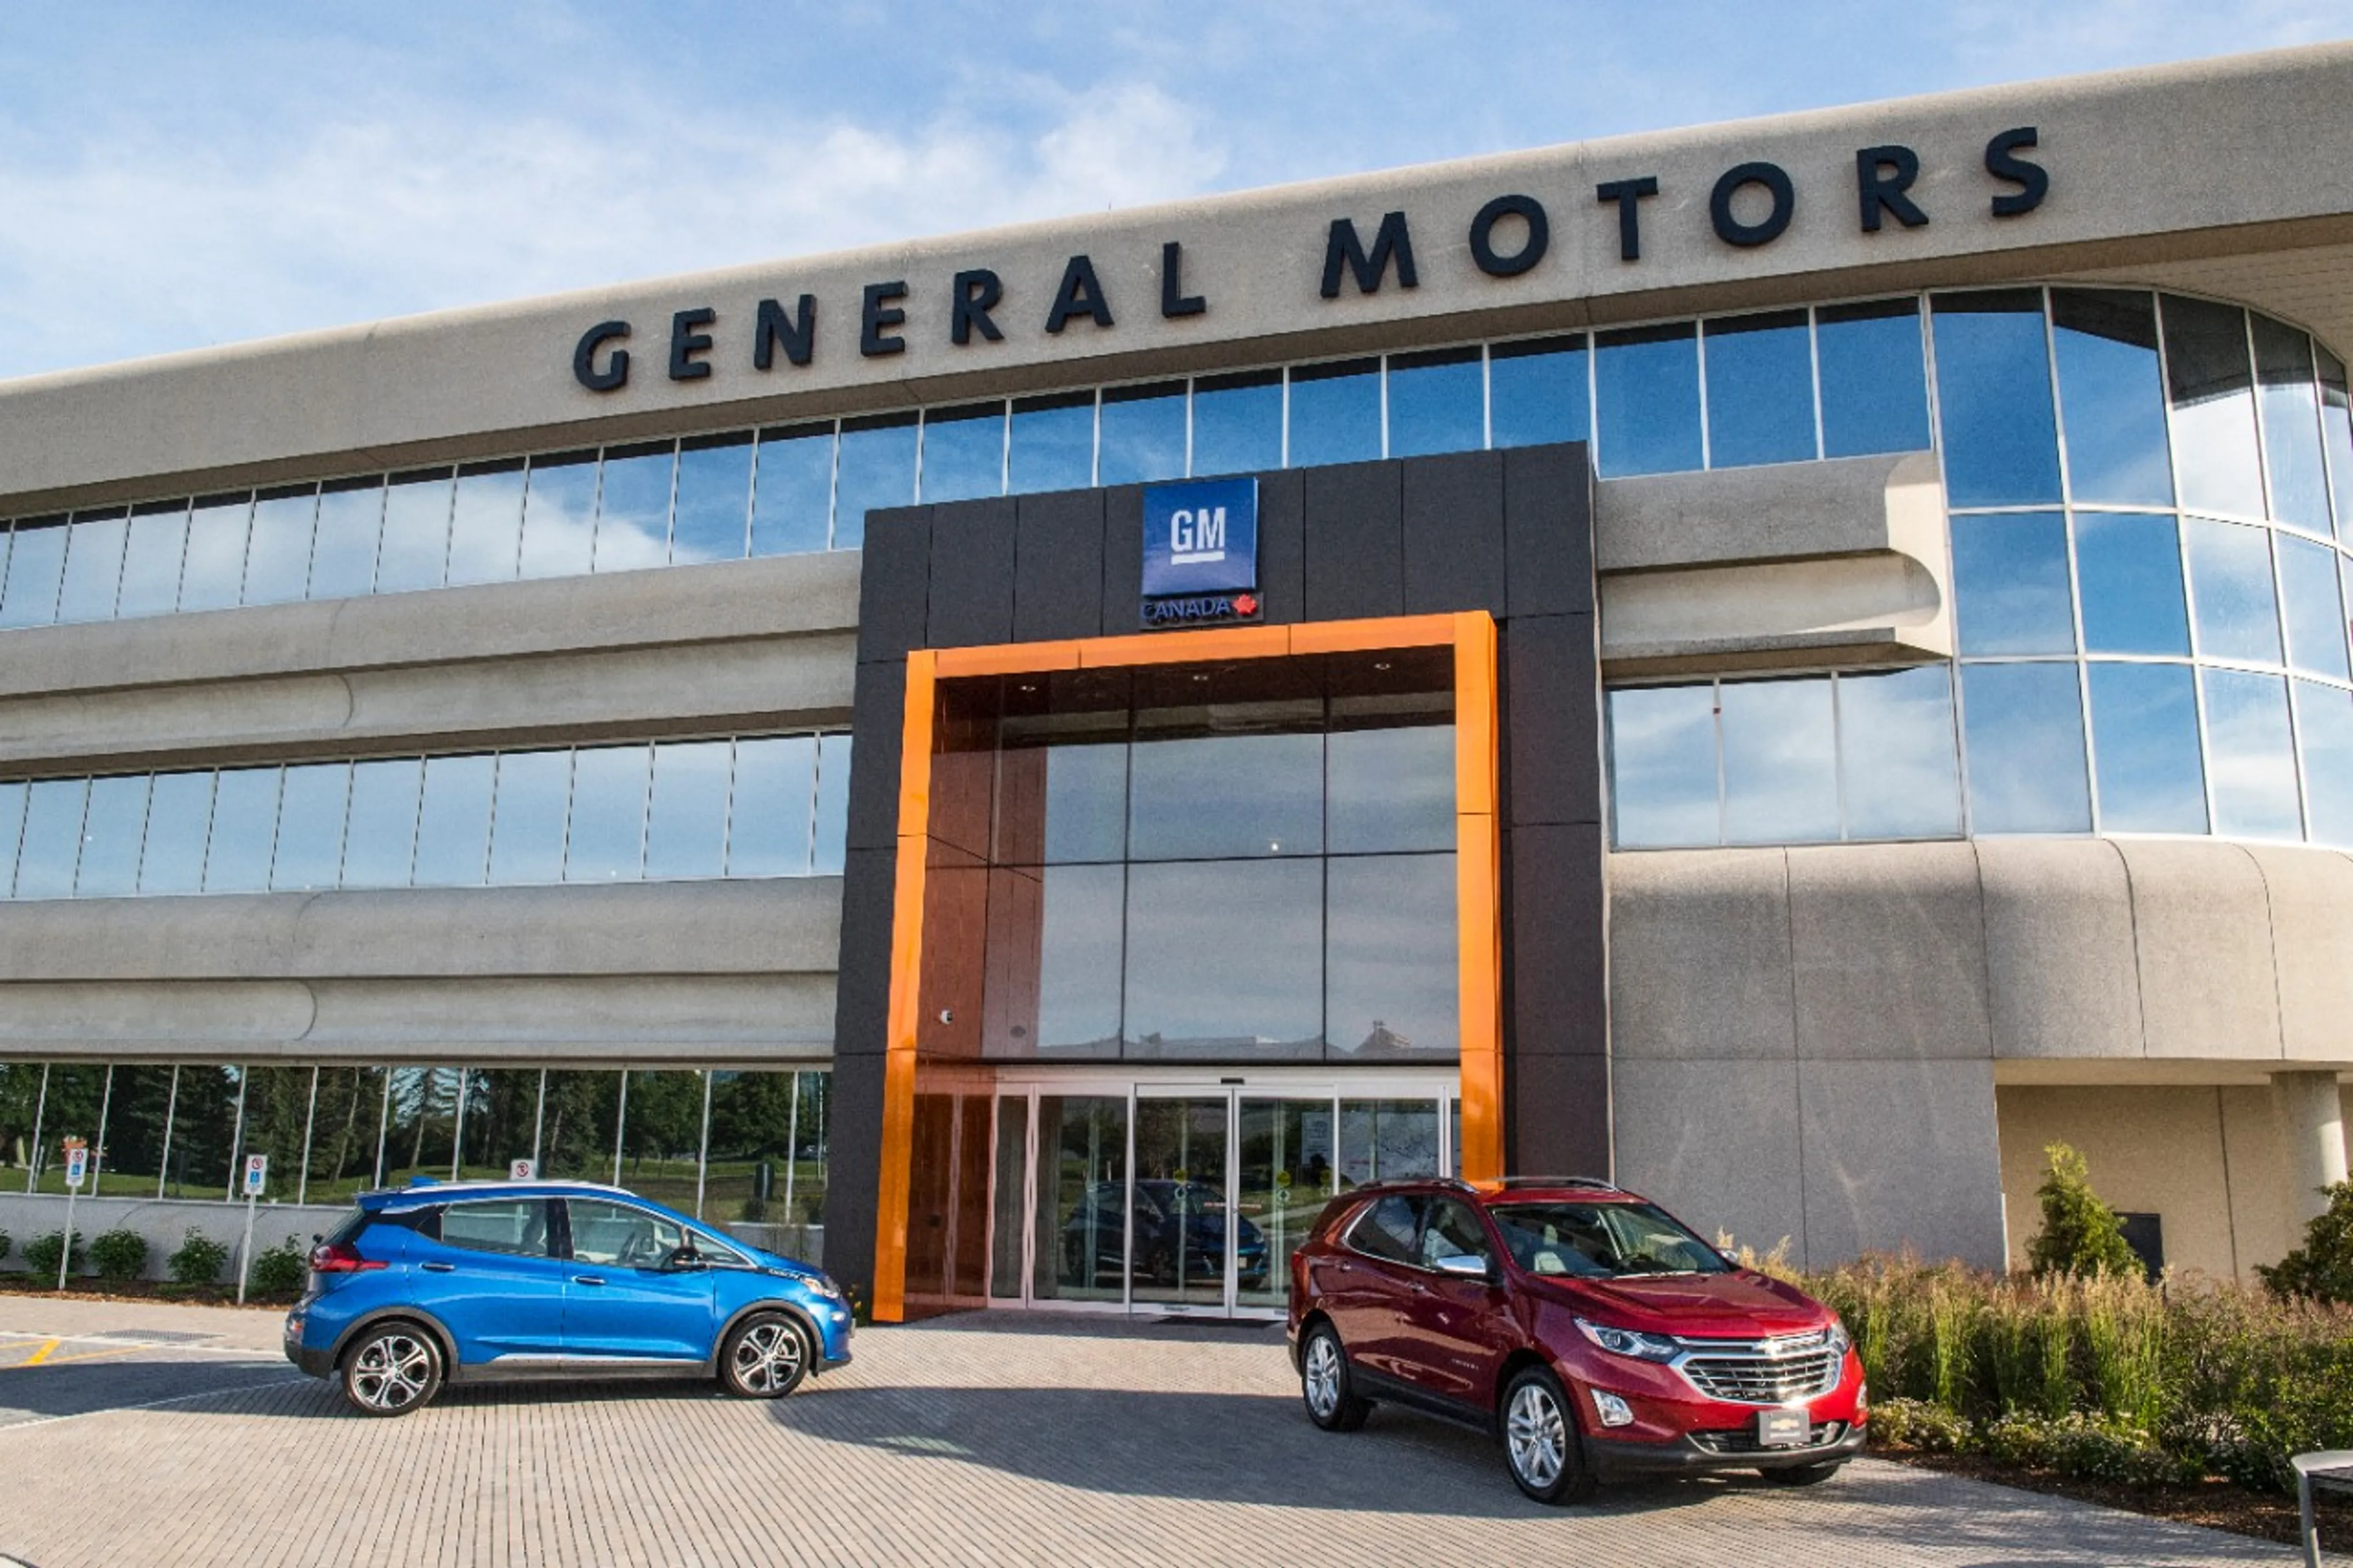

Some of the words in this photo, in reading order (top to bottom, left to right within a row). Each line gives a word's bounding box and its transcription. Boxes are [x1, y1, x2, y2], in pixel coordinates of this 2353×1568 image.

[573, 240, 1207, 393] GENERAL
[1319, 126, 2050, 301] MOTORS
[1170, 506, 1226, 553] GM
[1142, 597, 1231, 620] CANADA
